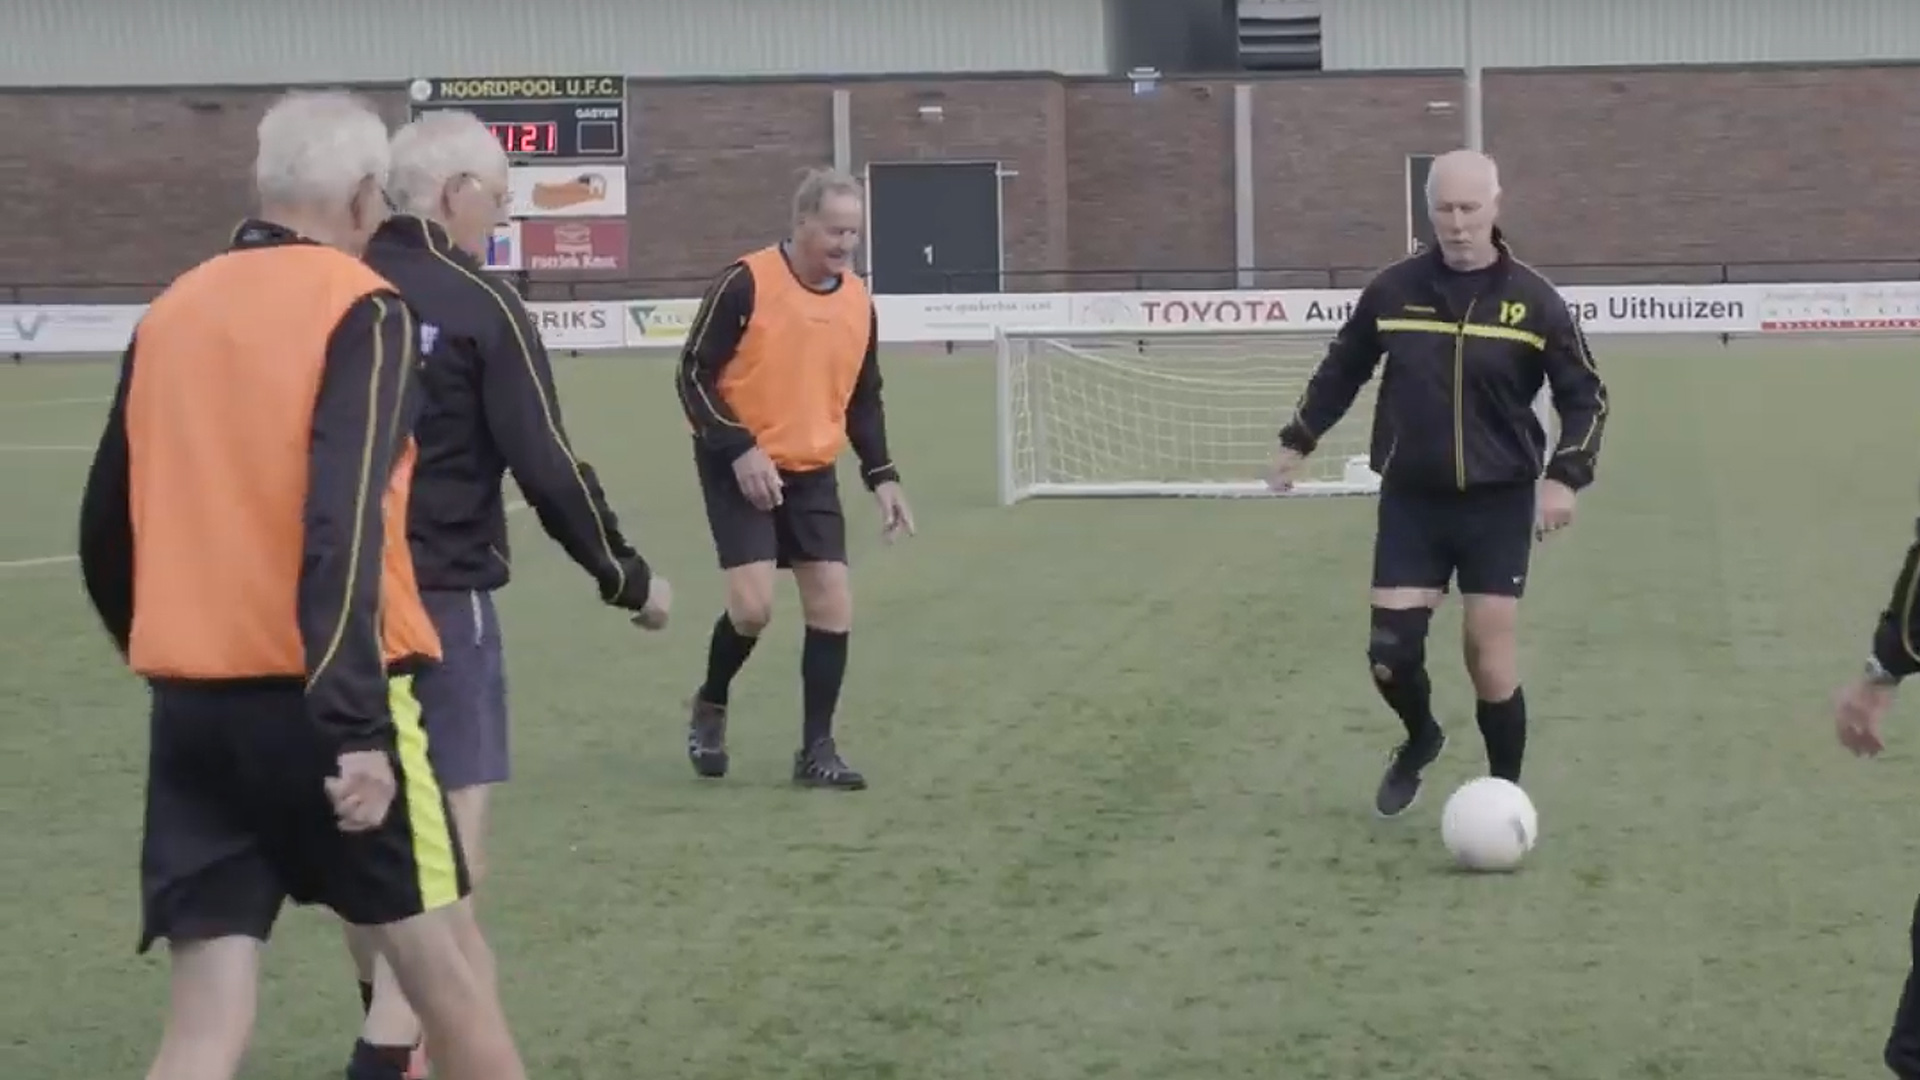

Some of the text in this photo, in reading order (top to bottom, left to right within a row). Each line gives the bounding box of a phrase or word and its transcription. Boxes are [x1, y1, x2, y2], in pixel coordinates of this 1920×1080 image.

[440, 78, 618, 99] NOORDPOOL U.F.C.
[924, 244, 933, 265] 1
[1139, 300, 1289, 323] TOYOTA
[1608, 296, 1744, 320] Uithuizen
[1499, 300, 1527, 326] 19
